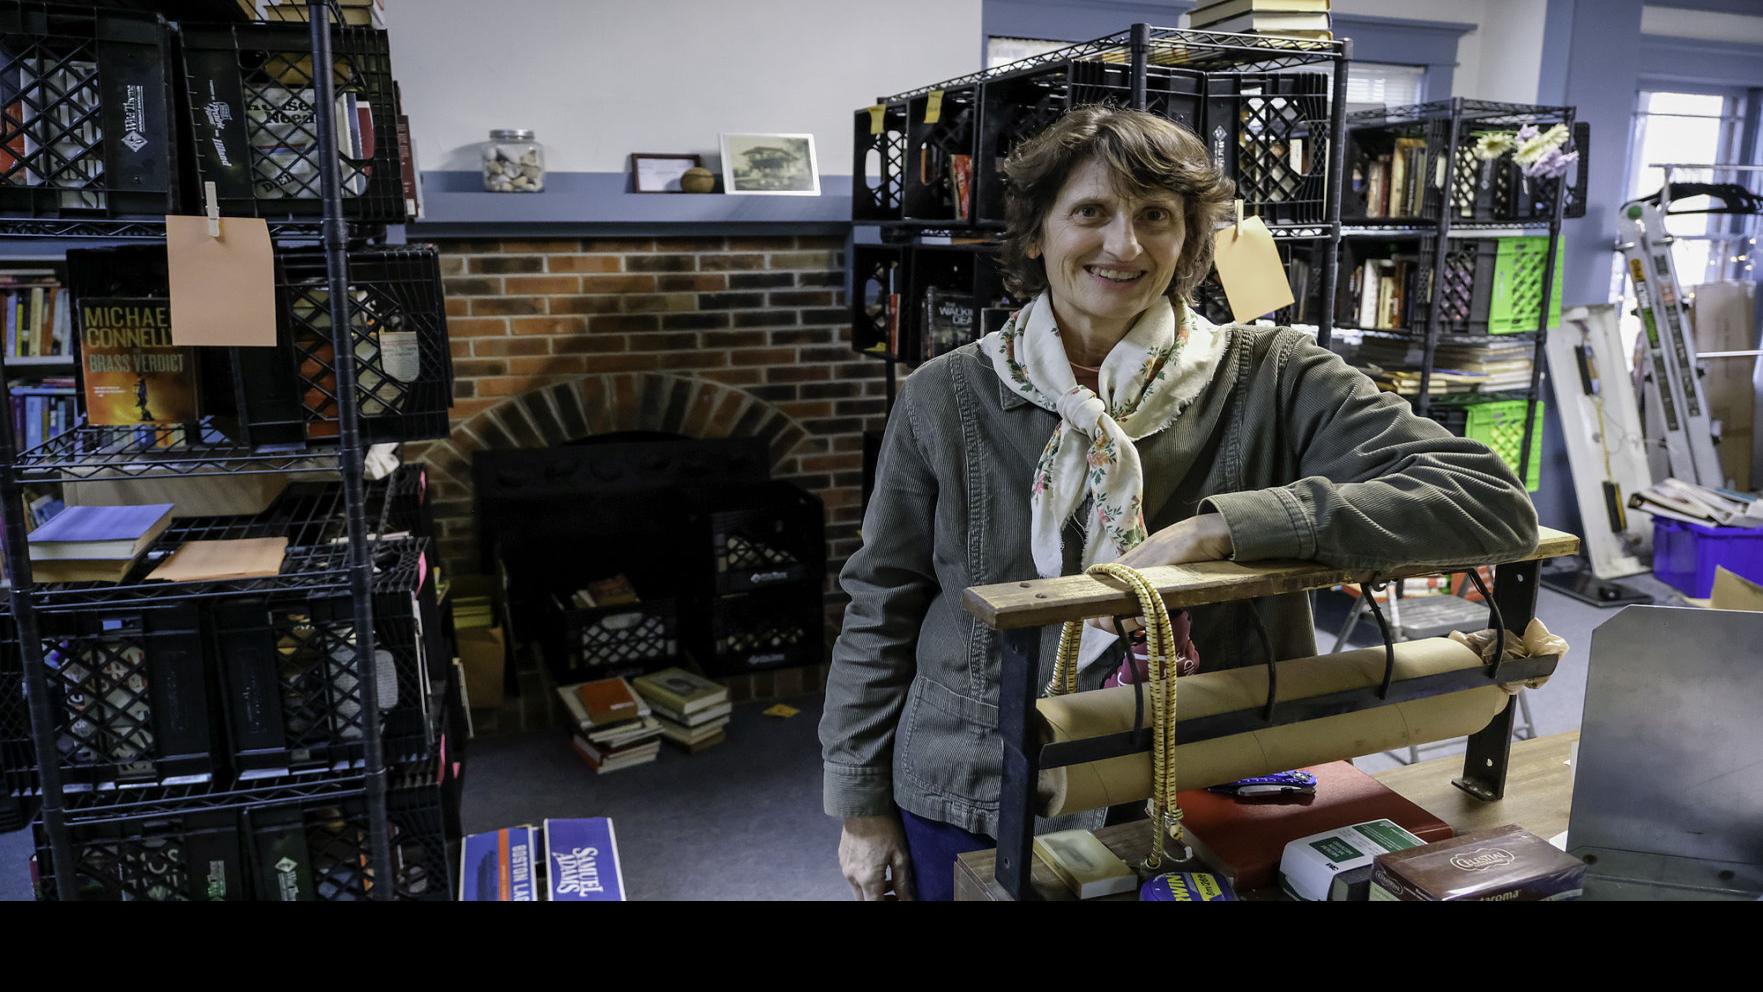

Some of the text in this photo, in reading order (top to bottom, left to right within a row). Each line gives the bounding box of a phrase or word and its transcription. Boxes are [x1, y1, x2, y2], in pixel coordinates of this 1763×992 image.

[84, 307, 169, 328] MICHAE
[86, 327, 172, 349] CONNELL
[89, 353, 184, 373] BRASS VERDICT
[512, 844, 529, 883] BOSTON
[551, 852, 580, 894] ADAMS
[572, 846, 604, 897] SAMUEL
